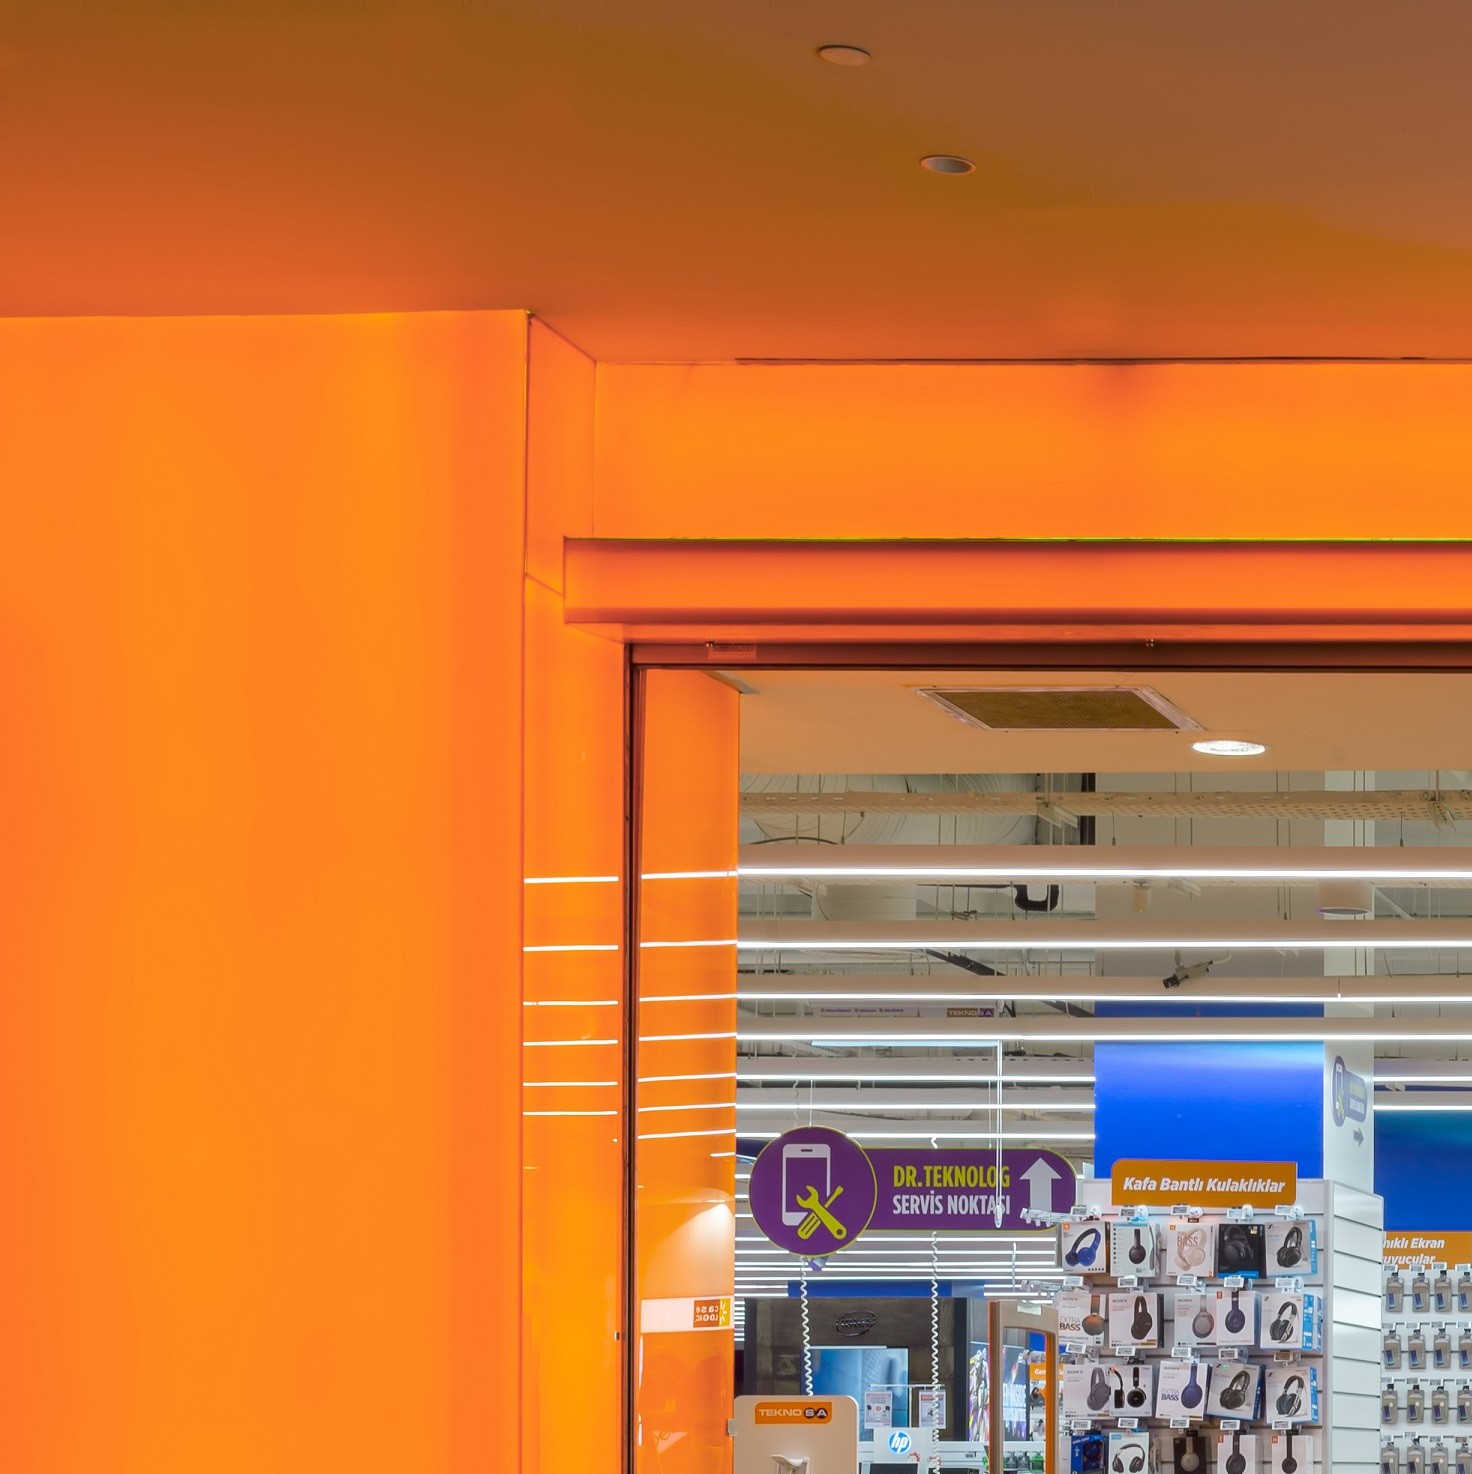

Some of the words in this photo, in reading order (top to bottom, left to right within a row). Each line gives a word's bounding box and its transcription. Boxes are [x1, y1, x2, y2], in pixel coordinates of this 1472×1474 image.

[1123, 1177, 1157, 1191] Kafa
[1159, 1178, 1204, 1192] Bantlı
[1206, 1178, 1286, 1193] Kulaklıklar
[892, 1190, 944, 1215] SERVİS
[947, 1195, 1011, 1215] NOKTASI
[1410, 1237, 1445, 1249] Ekran
[1383, 1253, 1436, 1265] uyucular
[1059, 1322, 1081, 1331] BASS
[1161, 1393, 1180, 1401] BASS
[758, 1408, 828, 1417] TEKNOSA
[890, 1432, 909, 1453] hp
